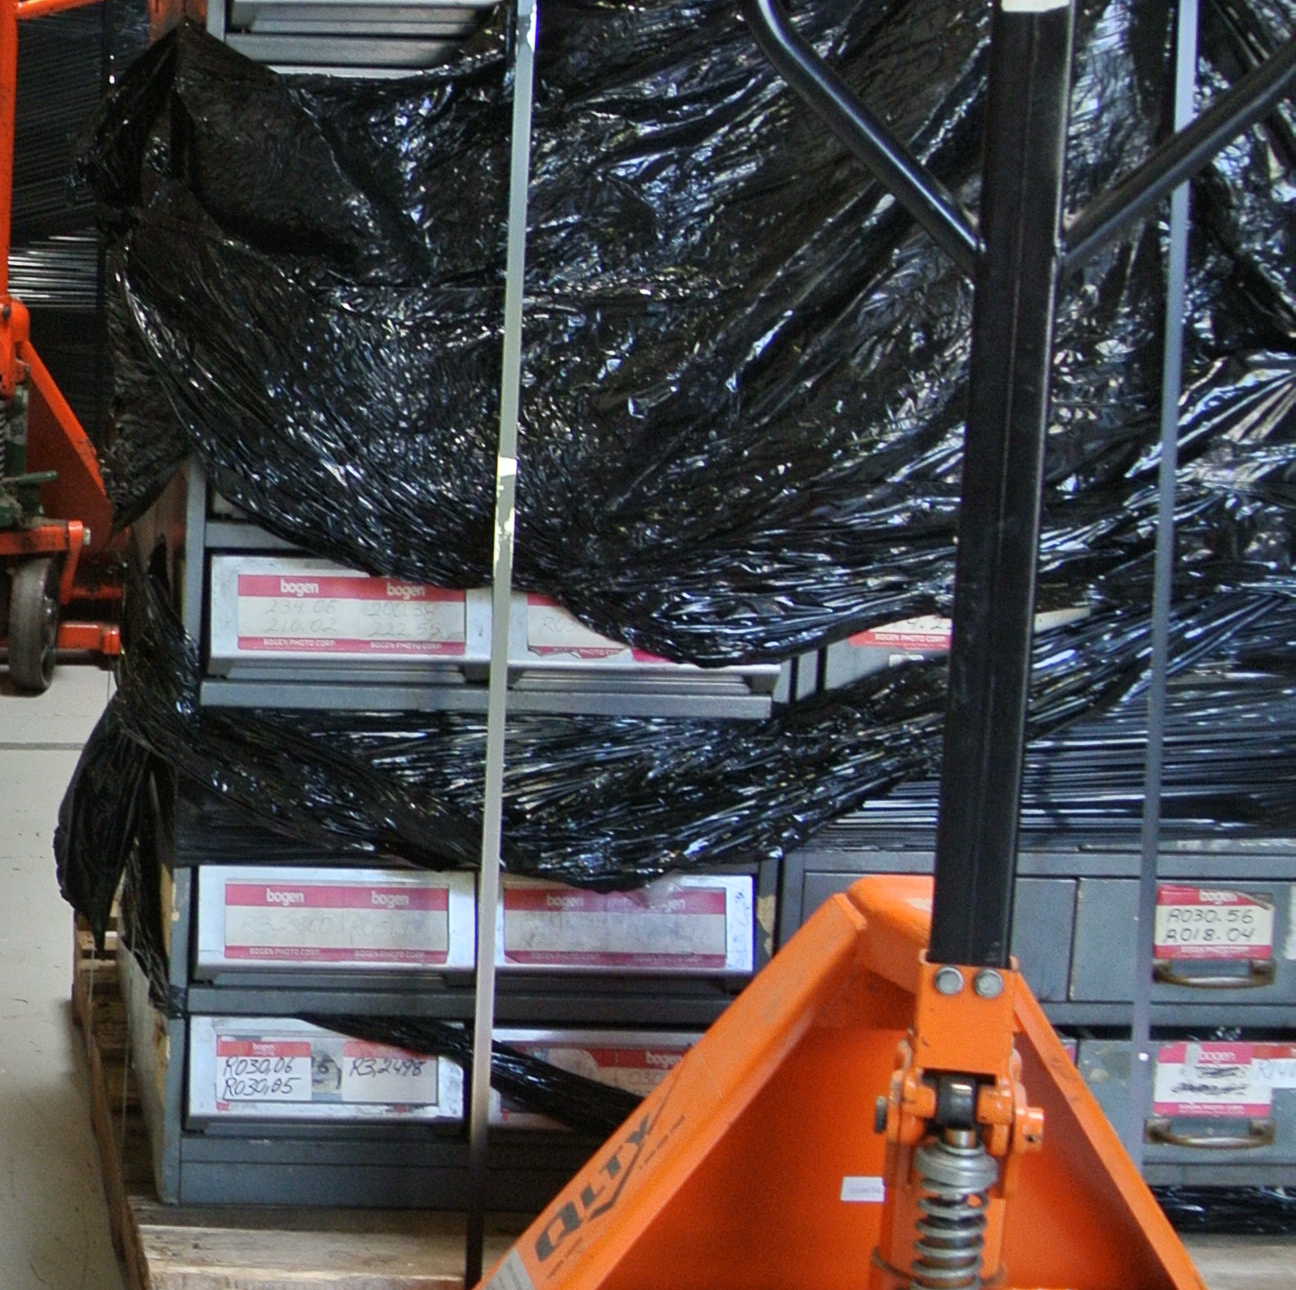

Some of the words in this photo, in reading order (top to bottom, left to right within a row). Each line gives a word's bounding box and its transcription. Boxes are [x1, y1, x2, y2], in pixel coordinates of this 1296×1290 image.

[279, 578, 319, 597] bogen
[386, 582, 425, 600] bogen
[289, 639, 314, 647] PHOTO
[874, 633, 899, 641] BOGEN
[900, 634, 925, 642] PHOTO
[266, 888, 304, 907] bogen
[371, 891, 409, 909] bogen
[1167, 908, 1254, 924] R030.56
[1163, 927, 1255, 944] R018.04
